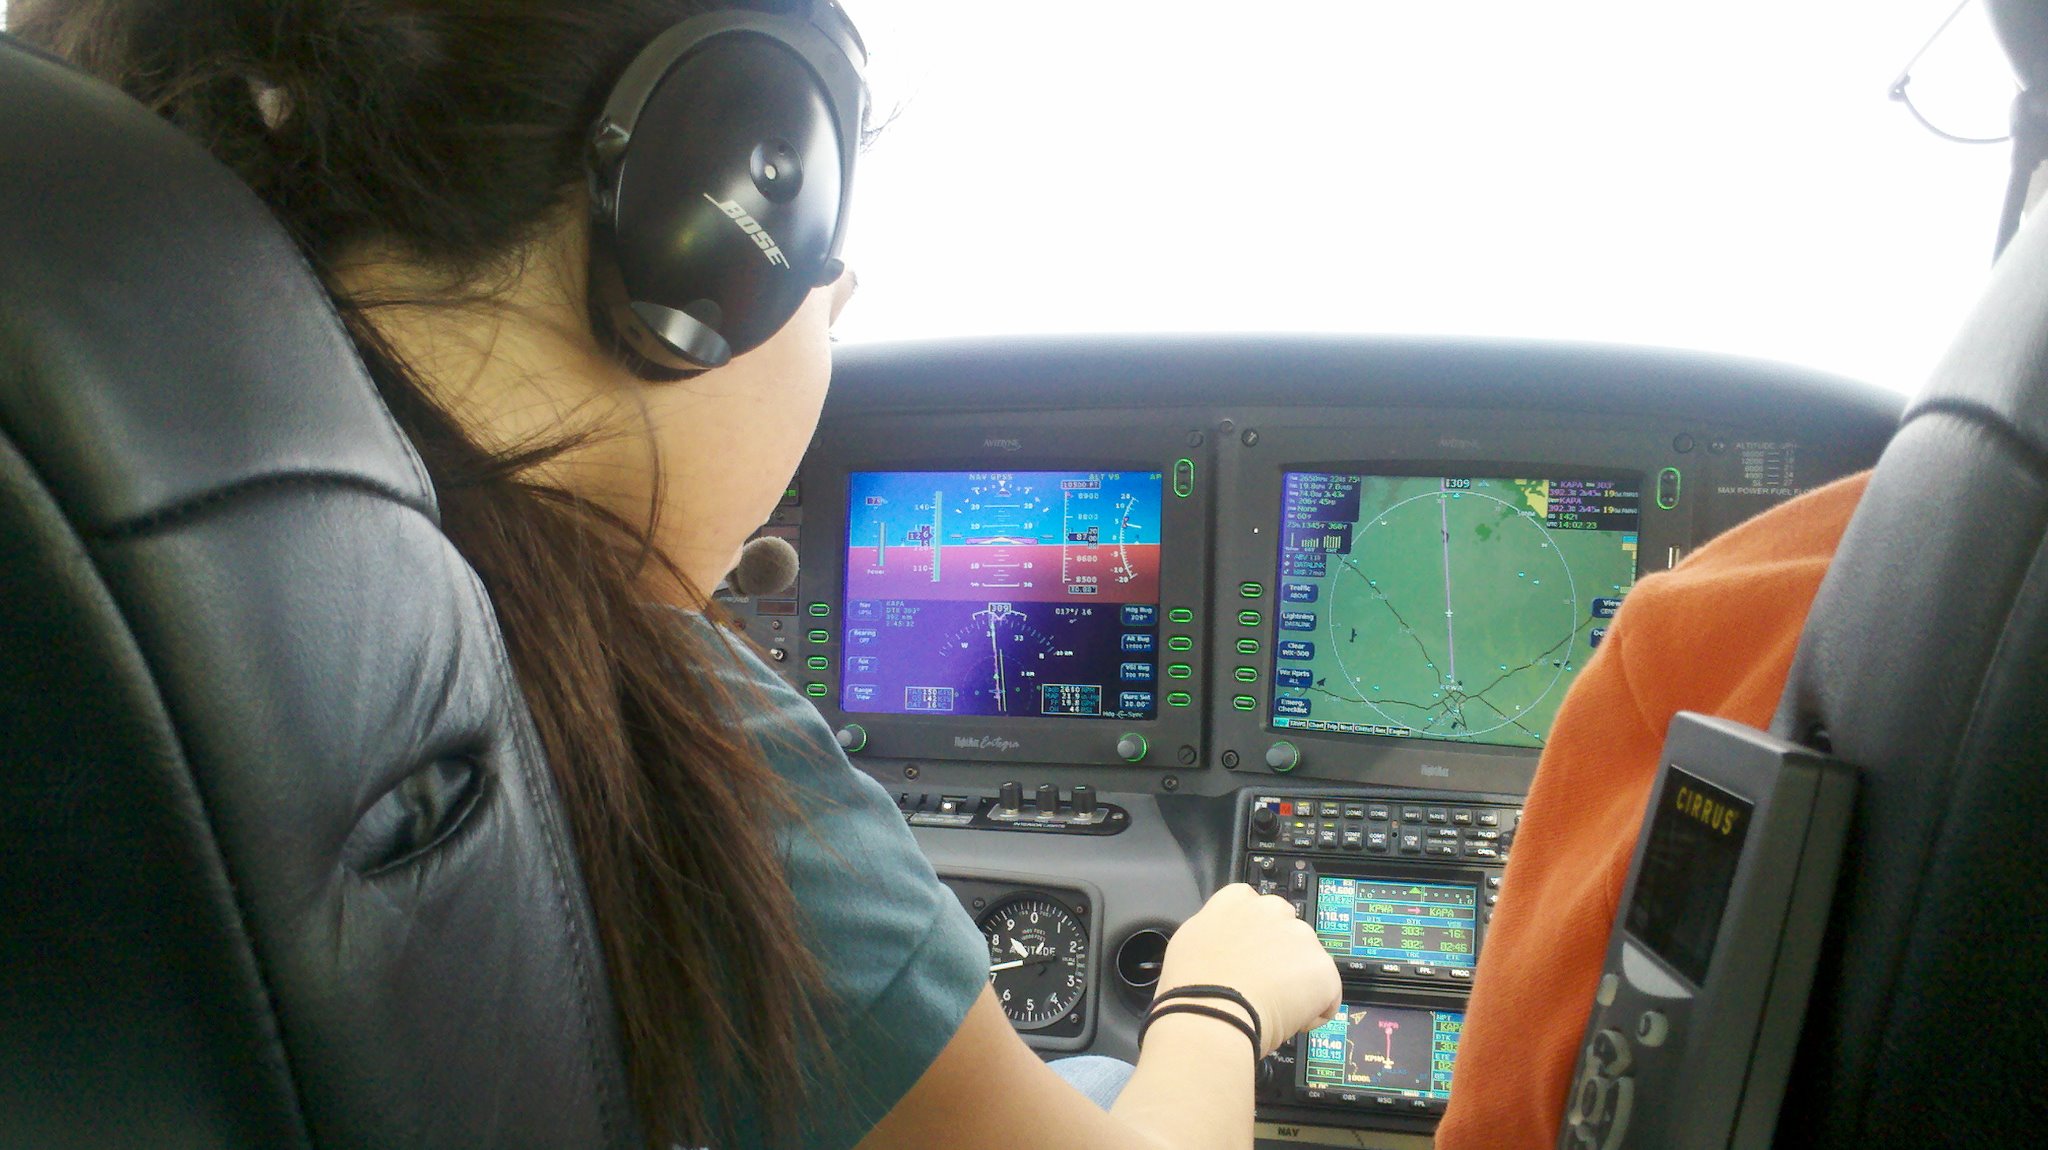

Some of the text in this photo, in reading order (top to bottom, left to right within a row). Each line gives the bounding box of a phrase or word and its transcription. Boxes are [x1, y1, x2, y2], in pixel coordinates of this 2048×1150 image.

[703, 192, 790, 269] BOSE
[1737, 487, 1769, 495] POWER
[1282, 613, 1314, 621] Lightning
[1278, 706, 1307, 714] Checklist
[1677, 786, 1735, 835] CIRRUS
[1320, 912, 1350, 921] 110.15
[1369, 904, 1454, 918] KPWA KAPA
[1030, 912, 1038, 924] 0
[1007, 919, 1015, 931] 9
[992, 934, 999, 946] 8
[1069, 941, 1077, 953] 2
[1440, 942, 1467, 953] 02:46
[990, 972, 997, 984] 7
[1451, 969, 1470, 977] PROC
[1067, 975, 1075, 987] 3
[1003, 989, 1011, 1001] 6
[1050, 992, 1058, 1004] 4
[1026, 999, 1034, 1011] 5
[1379, 1021, 1399, 1029] KAPA
[1311, 1038, 1342, 1049] 114.40
[1311, 1048, 1341, 1059] 109.15
[1278, 1127, 1299, 1137] NAV
